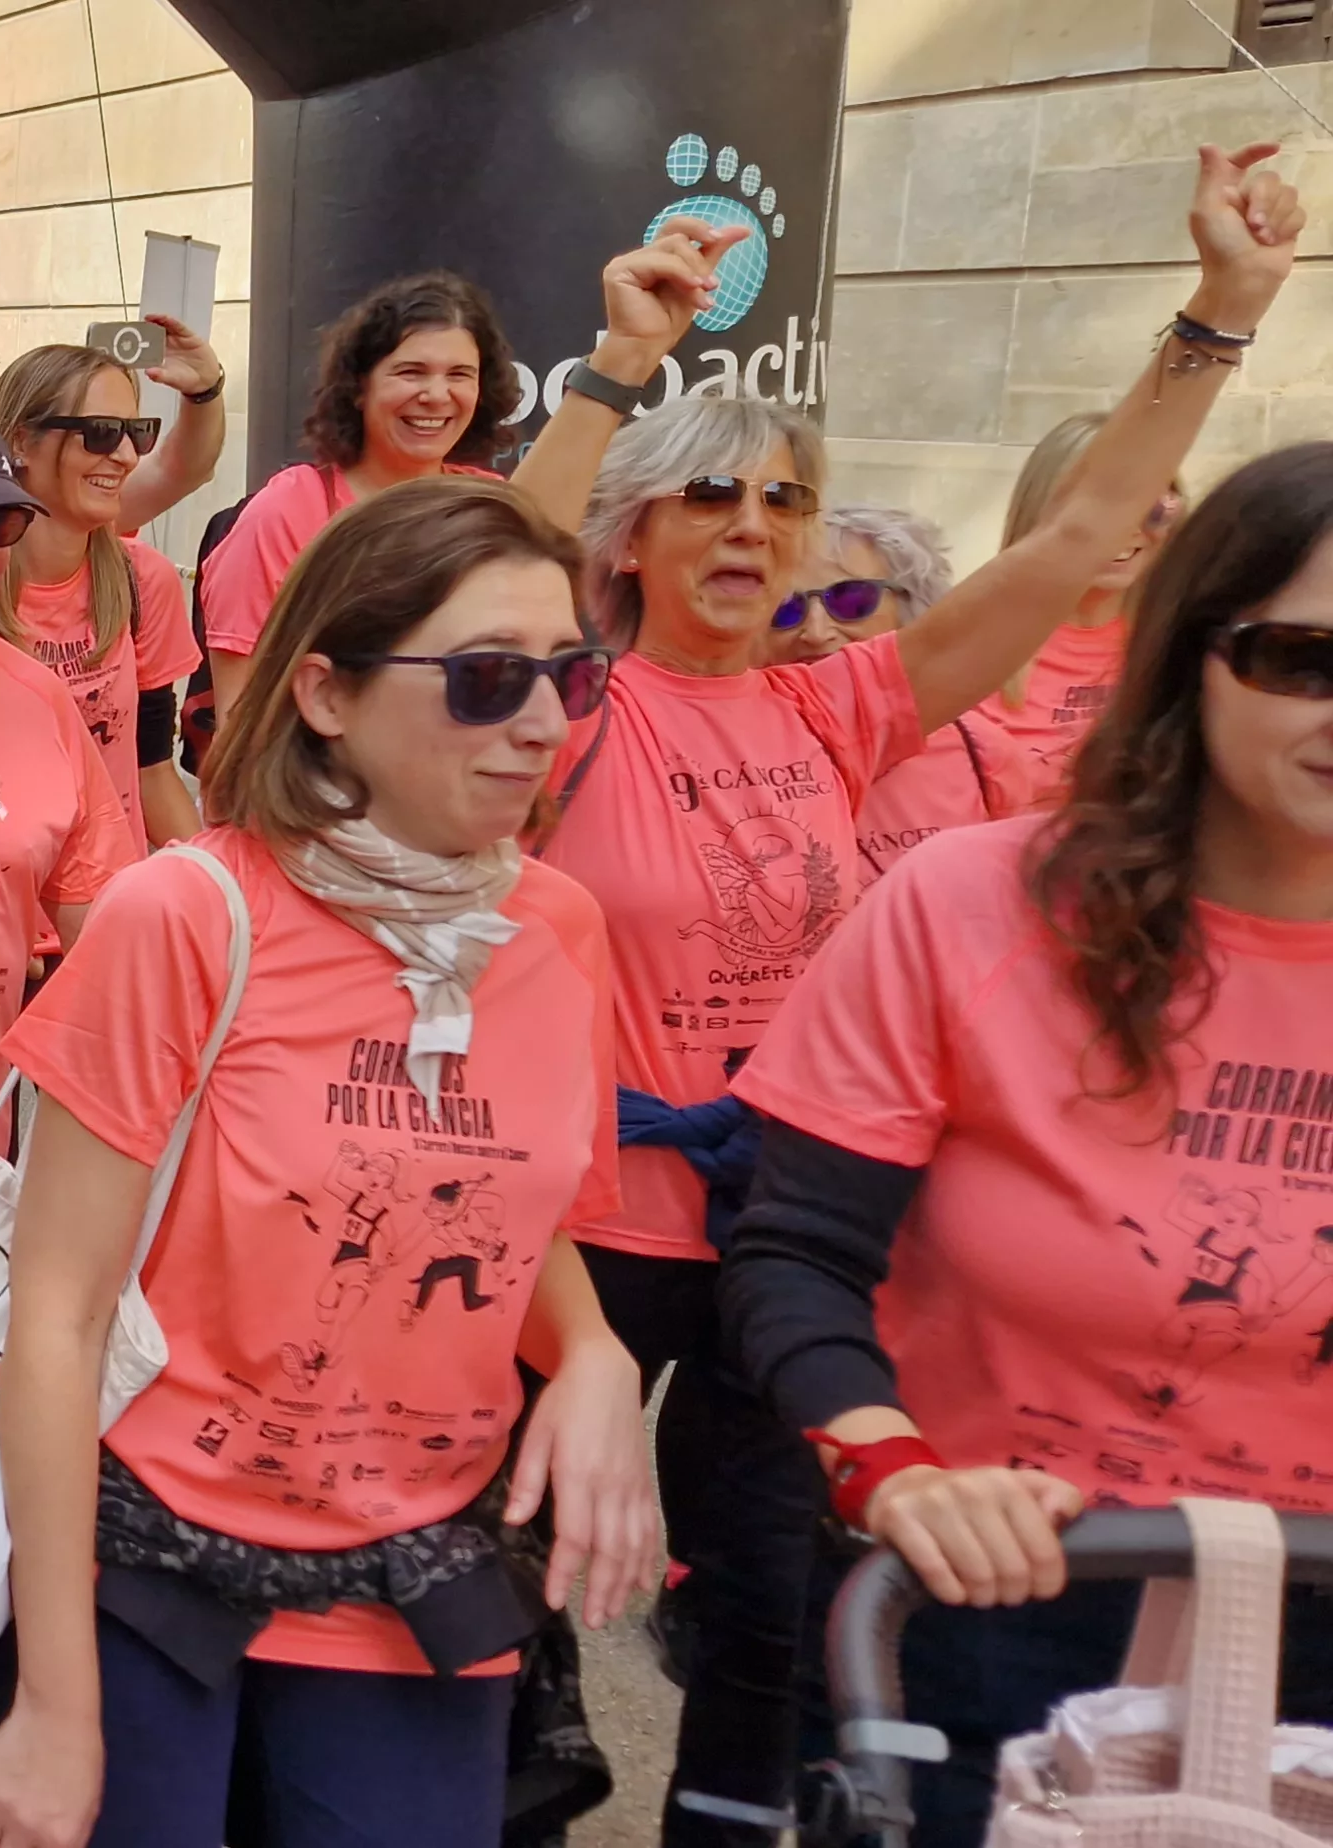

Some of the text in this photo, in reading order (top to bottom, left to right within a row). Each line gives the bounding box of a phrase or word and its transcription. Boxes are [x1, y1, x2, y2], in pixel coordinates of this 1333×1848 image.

[708, 964, 795, 986] QUIÉRETE
[324, 1082, 370, 1128] POR
[377, 1088, 402, 1131] LA
[1206, 1060, 1333, 1122] CORRAM
[1165, 1107, 1333, 1175] POR LA CIE
